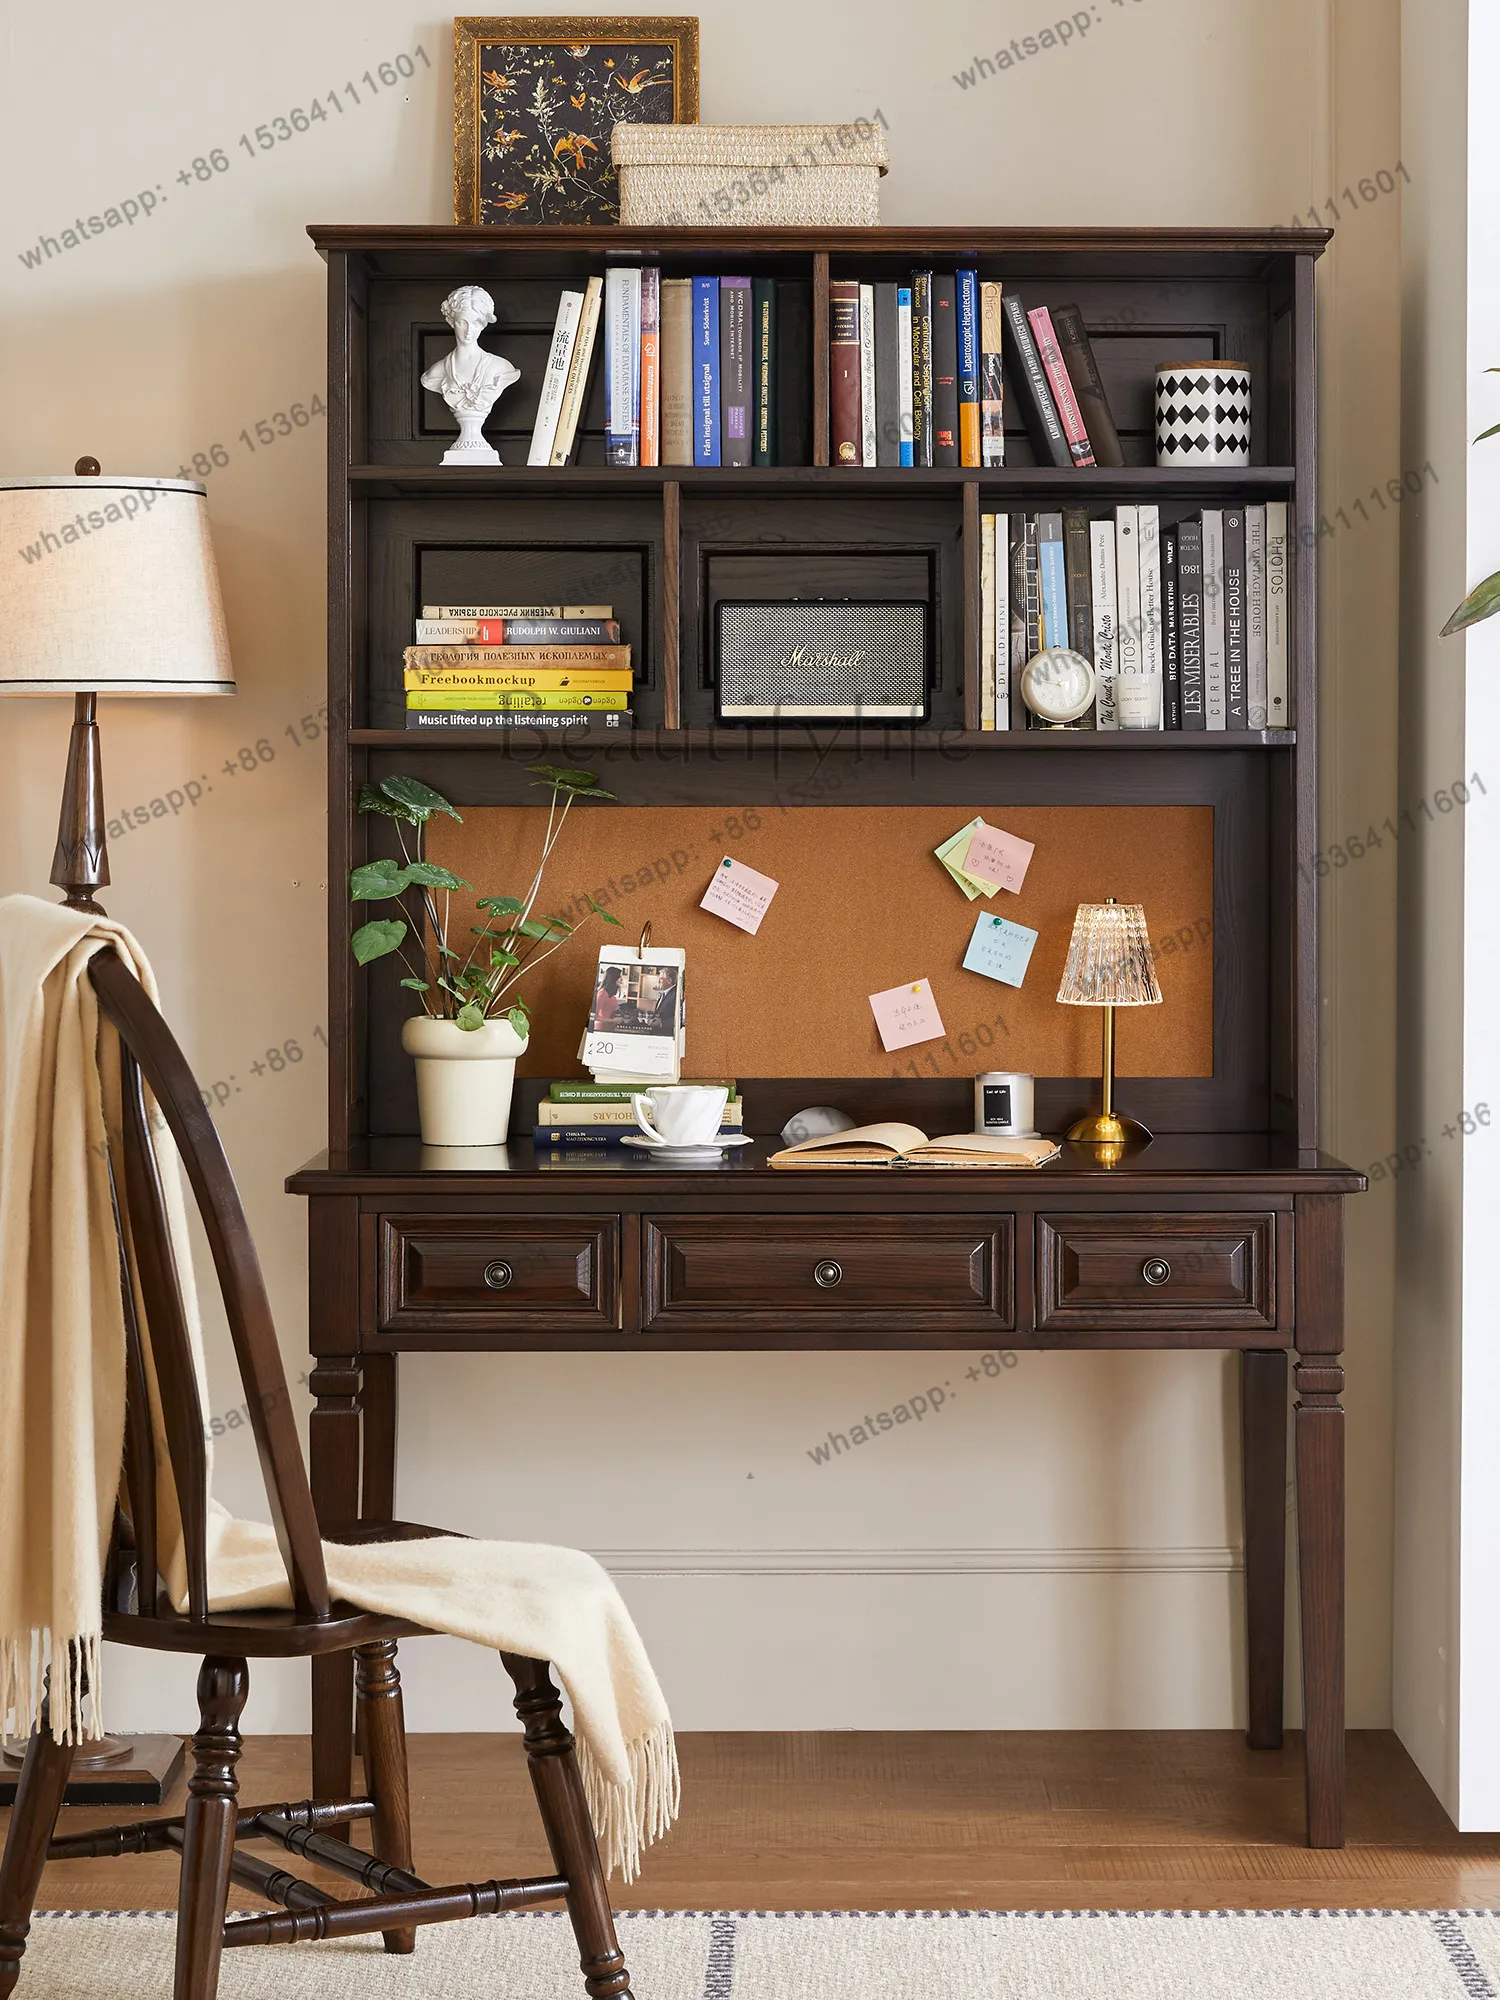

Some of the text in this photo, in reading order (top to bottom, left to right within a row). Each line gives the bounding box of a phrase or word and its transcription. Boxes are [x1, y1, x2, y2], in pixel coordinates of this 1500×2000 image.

[621, 279, 630, 342] FUNDAMENTALS
[703, 297, 711, 346] Sune Söderkvist
[1009, 301, 1024, 325] СТРАНЫ
[961, 278, 972, 372] Laparoscopic Hepatectomy
[621, 343, 630, 353] OF
[913, 326, 921, 367] Molecular
[921, 315, 931, 360] Centrifugal
[1015, 323, 1038, 375] РАЗВИВАЮЩИЕСЯ
[621, 356, 630, 397] DATABASE
[913, 370, 921, 386] and
[1056, 378, 1067, 396] NEW
[703, 364, 712, 456] Från insignal till utsignal
[913, 391, 921, 406] Cell
[1035, 381, 1061, 440] КАПИТАЛИСТИЧЕСКИЕ
[621, 398, 630, 431] SYSTEMS
[912, 410, 922, 440] Biology
[1099, 549, 1107, 569] Dumas
[1166, 541, 1174, 564] WILEY
[1181, 564, 1200, 574] 1861
[1271, 536, 1283, 595] PHOTOS
[1099, 570, 1107, 600] Alexandre
[1146, 568, 1154, 592] House
[1252, 522, 1261, 638] THE VINTAGE HOUSE
[448, 607, 555, 617] УЧЕБНИК РУССКОГО ЯЗЫКА
[1146, 594, 1155, 616] Better
[425, 626, 477, 636] LEADERSHIP
[506, 626, 601, 636] RUDOLPH W. GIULIANI
[1146, 627, 1155, 650] Guide
[1167, 581, 1177, 681] BIG DATA MARKETING
[1229, 569, 1241, 716] A TREE IN THE HOUSE
[430, 650, 608, 662] ГЕОЛОГИЯ ПОЛЕЗНЫХ ИСКОПАЕМЫХ
[780, 645, 866, 668] Marshall
[1123, 637, 1136, 675] OTOS
[1182, 593, 1202, 714] LES MISERABLES
[421, 674, 536, 687] Freebookmockup
[1098, 614, 1116, 724] The Count of Monte Cristo
[1209, 650, 1220, 716] CEREAL
[498, 693, 547, 708] retailing
[558, 697, 616, 706] Ogden Ogden
[418, 715, 588, 728] Music lifted up the listening spirit
[596, 1041, 614, 1055] 20
[593, 1112, 632, 1120] HOLARS
